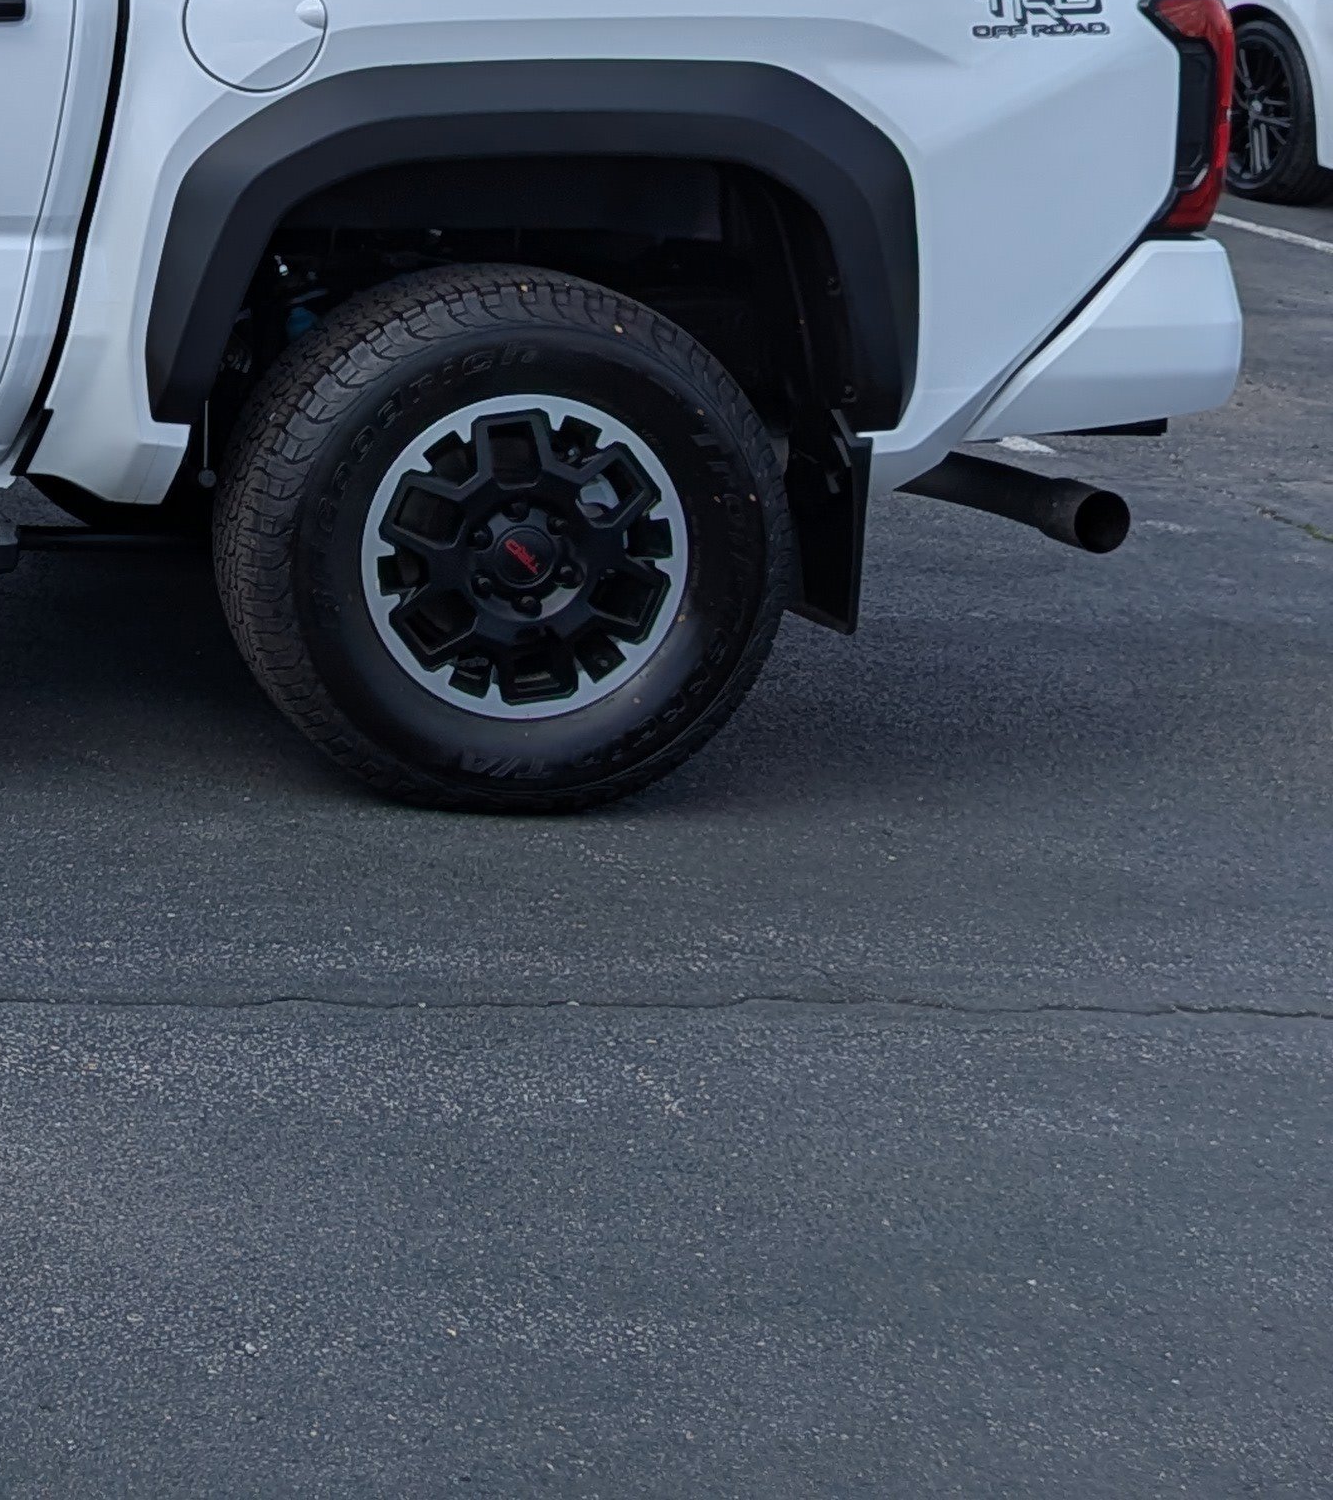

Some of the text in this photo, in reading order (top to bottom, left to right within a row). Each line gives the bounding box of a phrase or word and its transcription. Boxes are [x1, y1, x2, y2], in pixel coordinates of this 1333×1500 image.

[972, 22, 1110, 39] OFF ROAD
[504, 538, 541, 575] TRD
